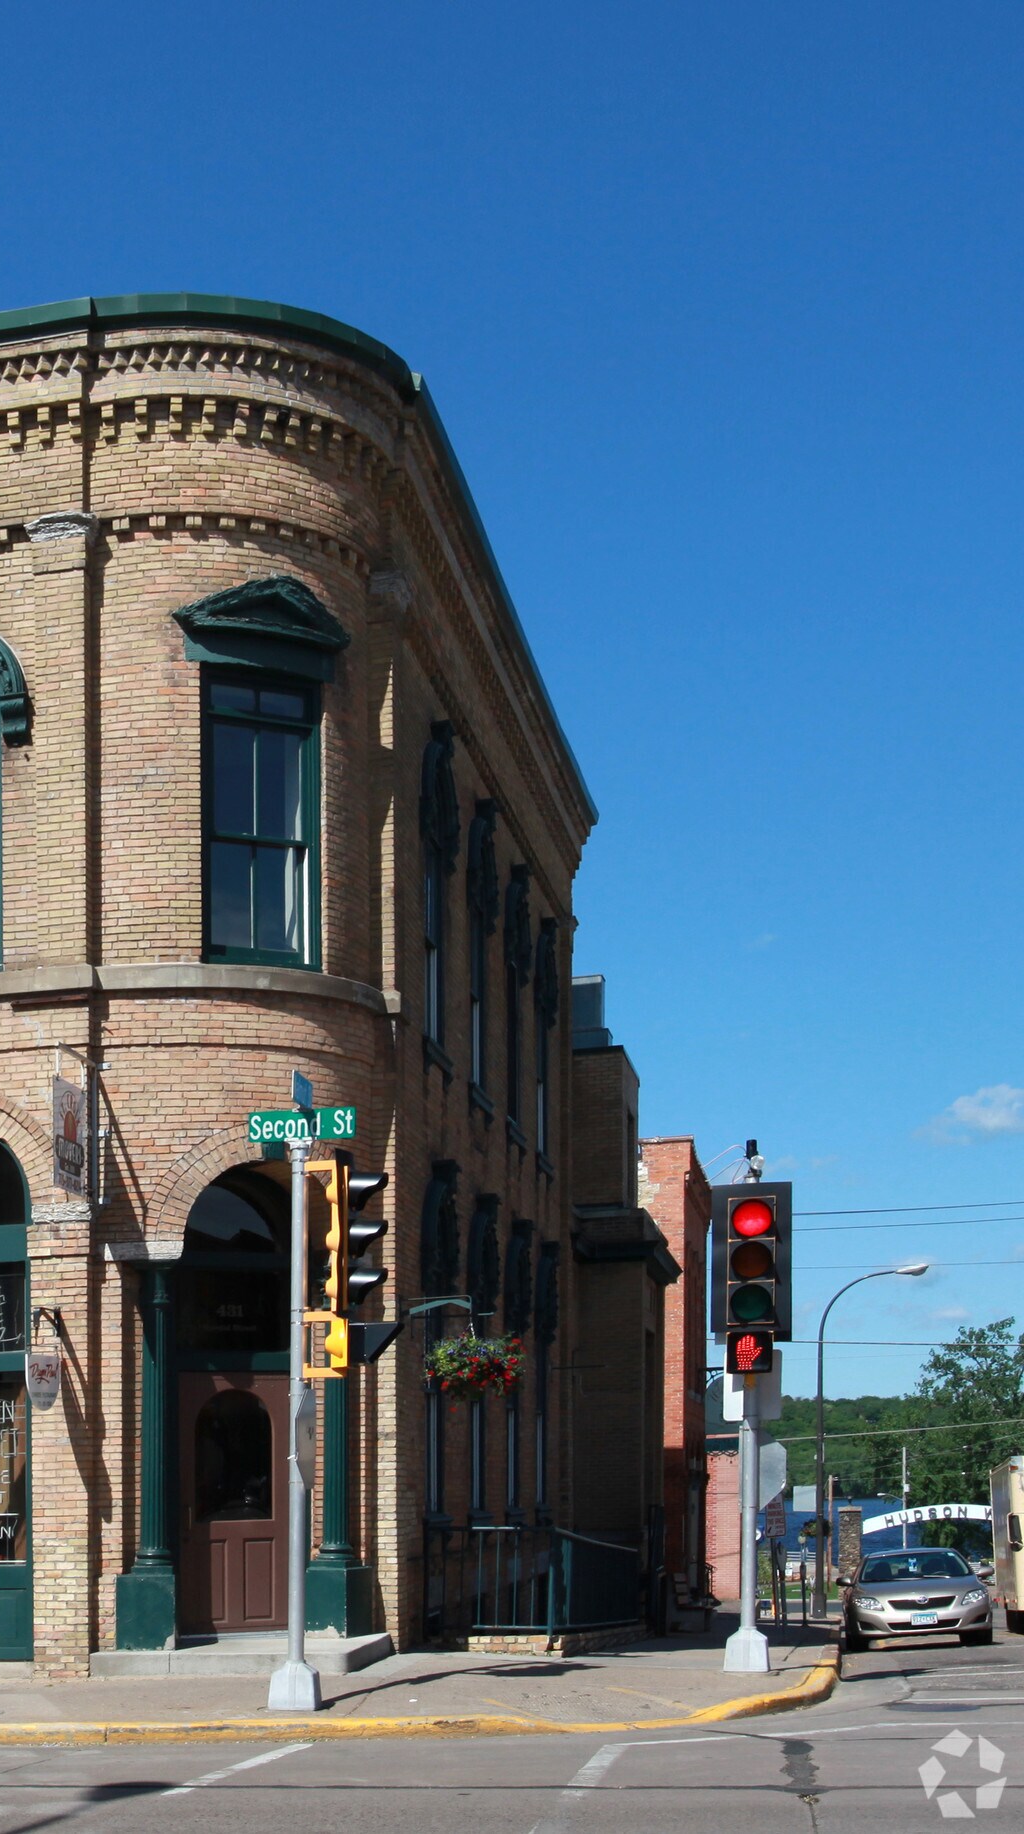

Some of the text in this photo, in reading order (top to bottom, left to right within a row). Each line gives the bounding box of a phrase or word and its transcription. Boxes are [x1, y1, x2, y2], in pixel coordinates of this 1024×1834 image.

[249, 1109, 353, 1140] Second St
[884, 1506, 968, 1528] HUDSON
